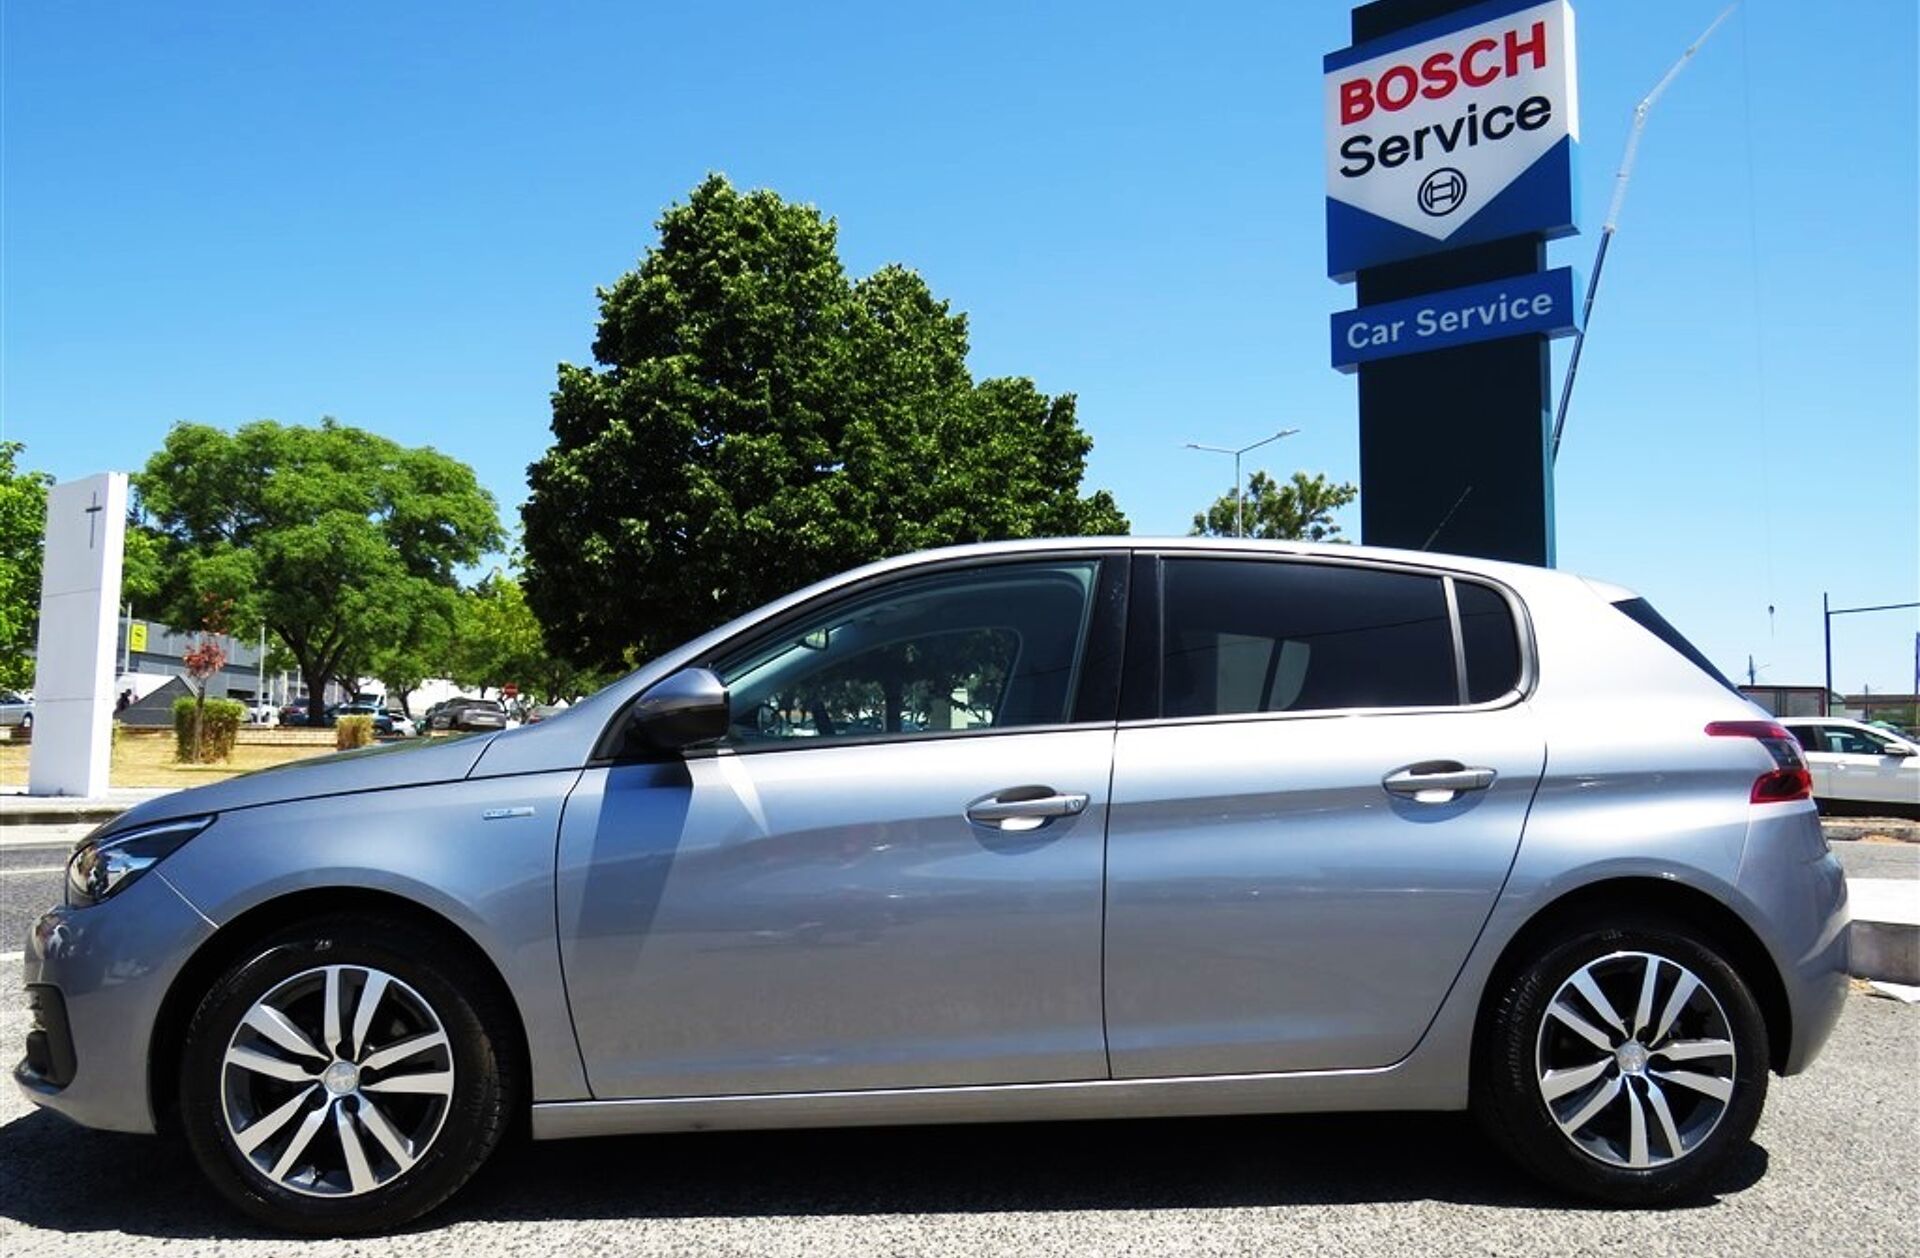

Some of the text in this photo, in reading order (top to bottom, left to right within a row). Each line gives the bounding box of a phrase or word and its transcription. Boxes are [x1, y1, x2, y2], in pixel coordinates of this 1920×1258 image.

[1340, 21, 1546, 125] BOSCH
[1340, 95, 1551, 178] Service
[1347, 293, 1553, 348] Car Service
